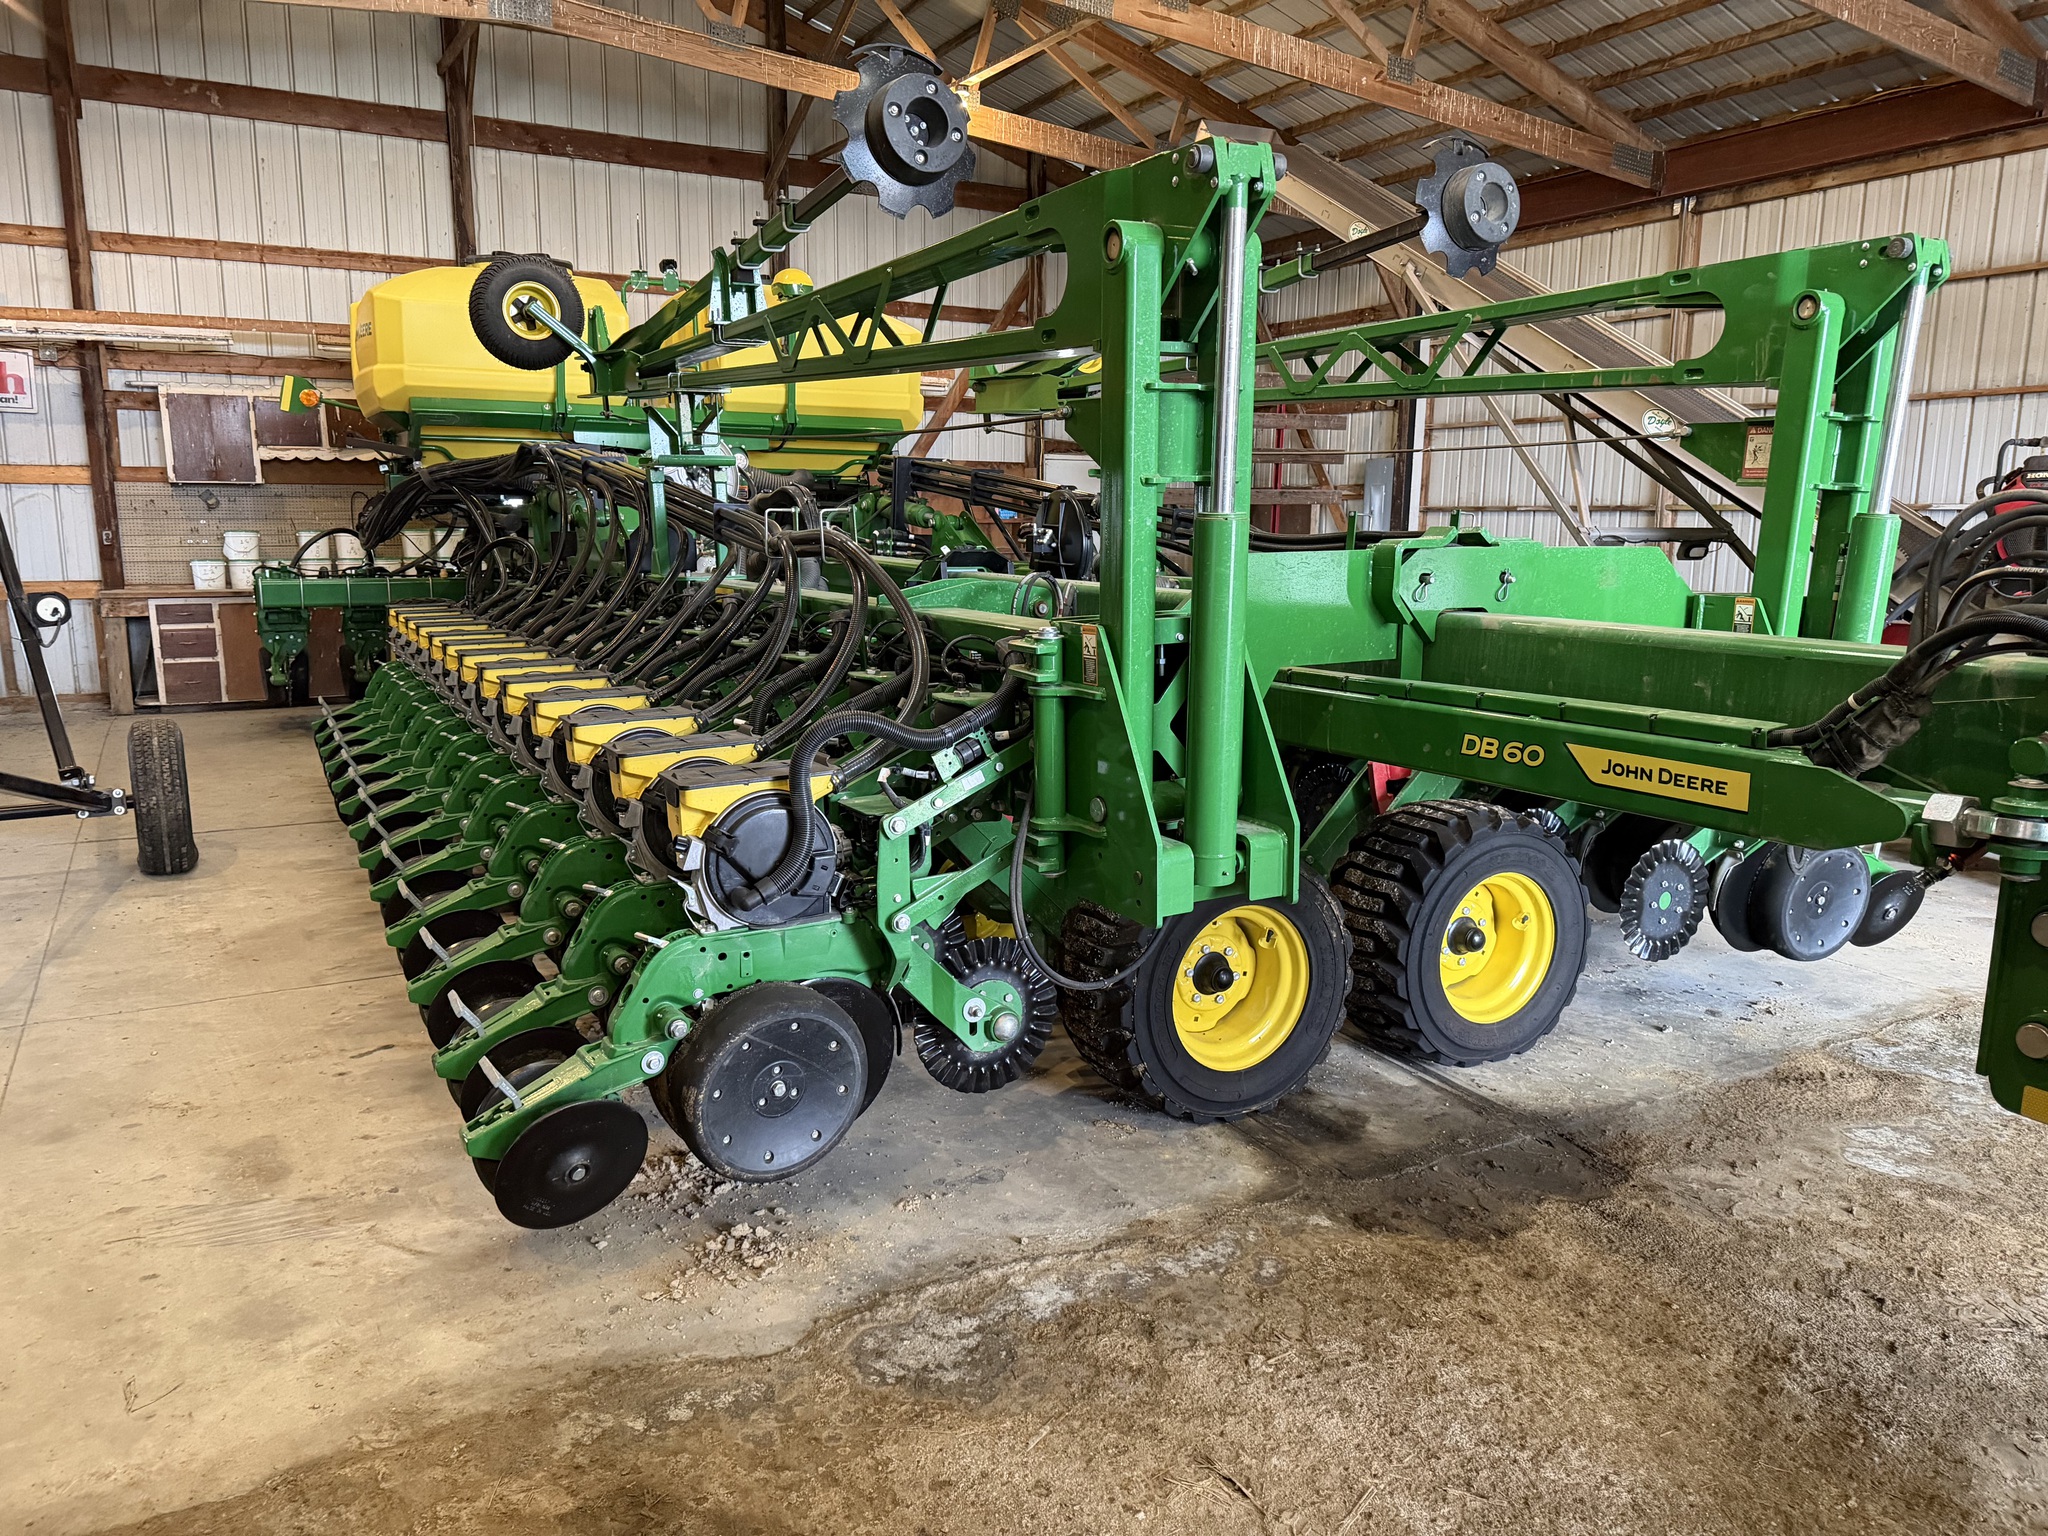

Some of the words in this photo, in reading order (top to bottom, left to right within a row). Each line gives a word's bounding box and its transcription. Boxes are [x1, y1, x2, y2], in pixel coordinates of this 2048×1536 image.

[1460, 733, 1500, 760] DB
[1502, 741, 1545, 767] 60
[1601, 758, 1653, 783] JOHN
[1658, 767, 1729, 796] DEERE
